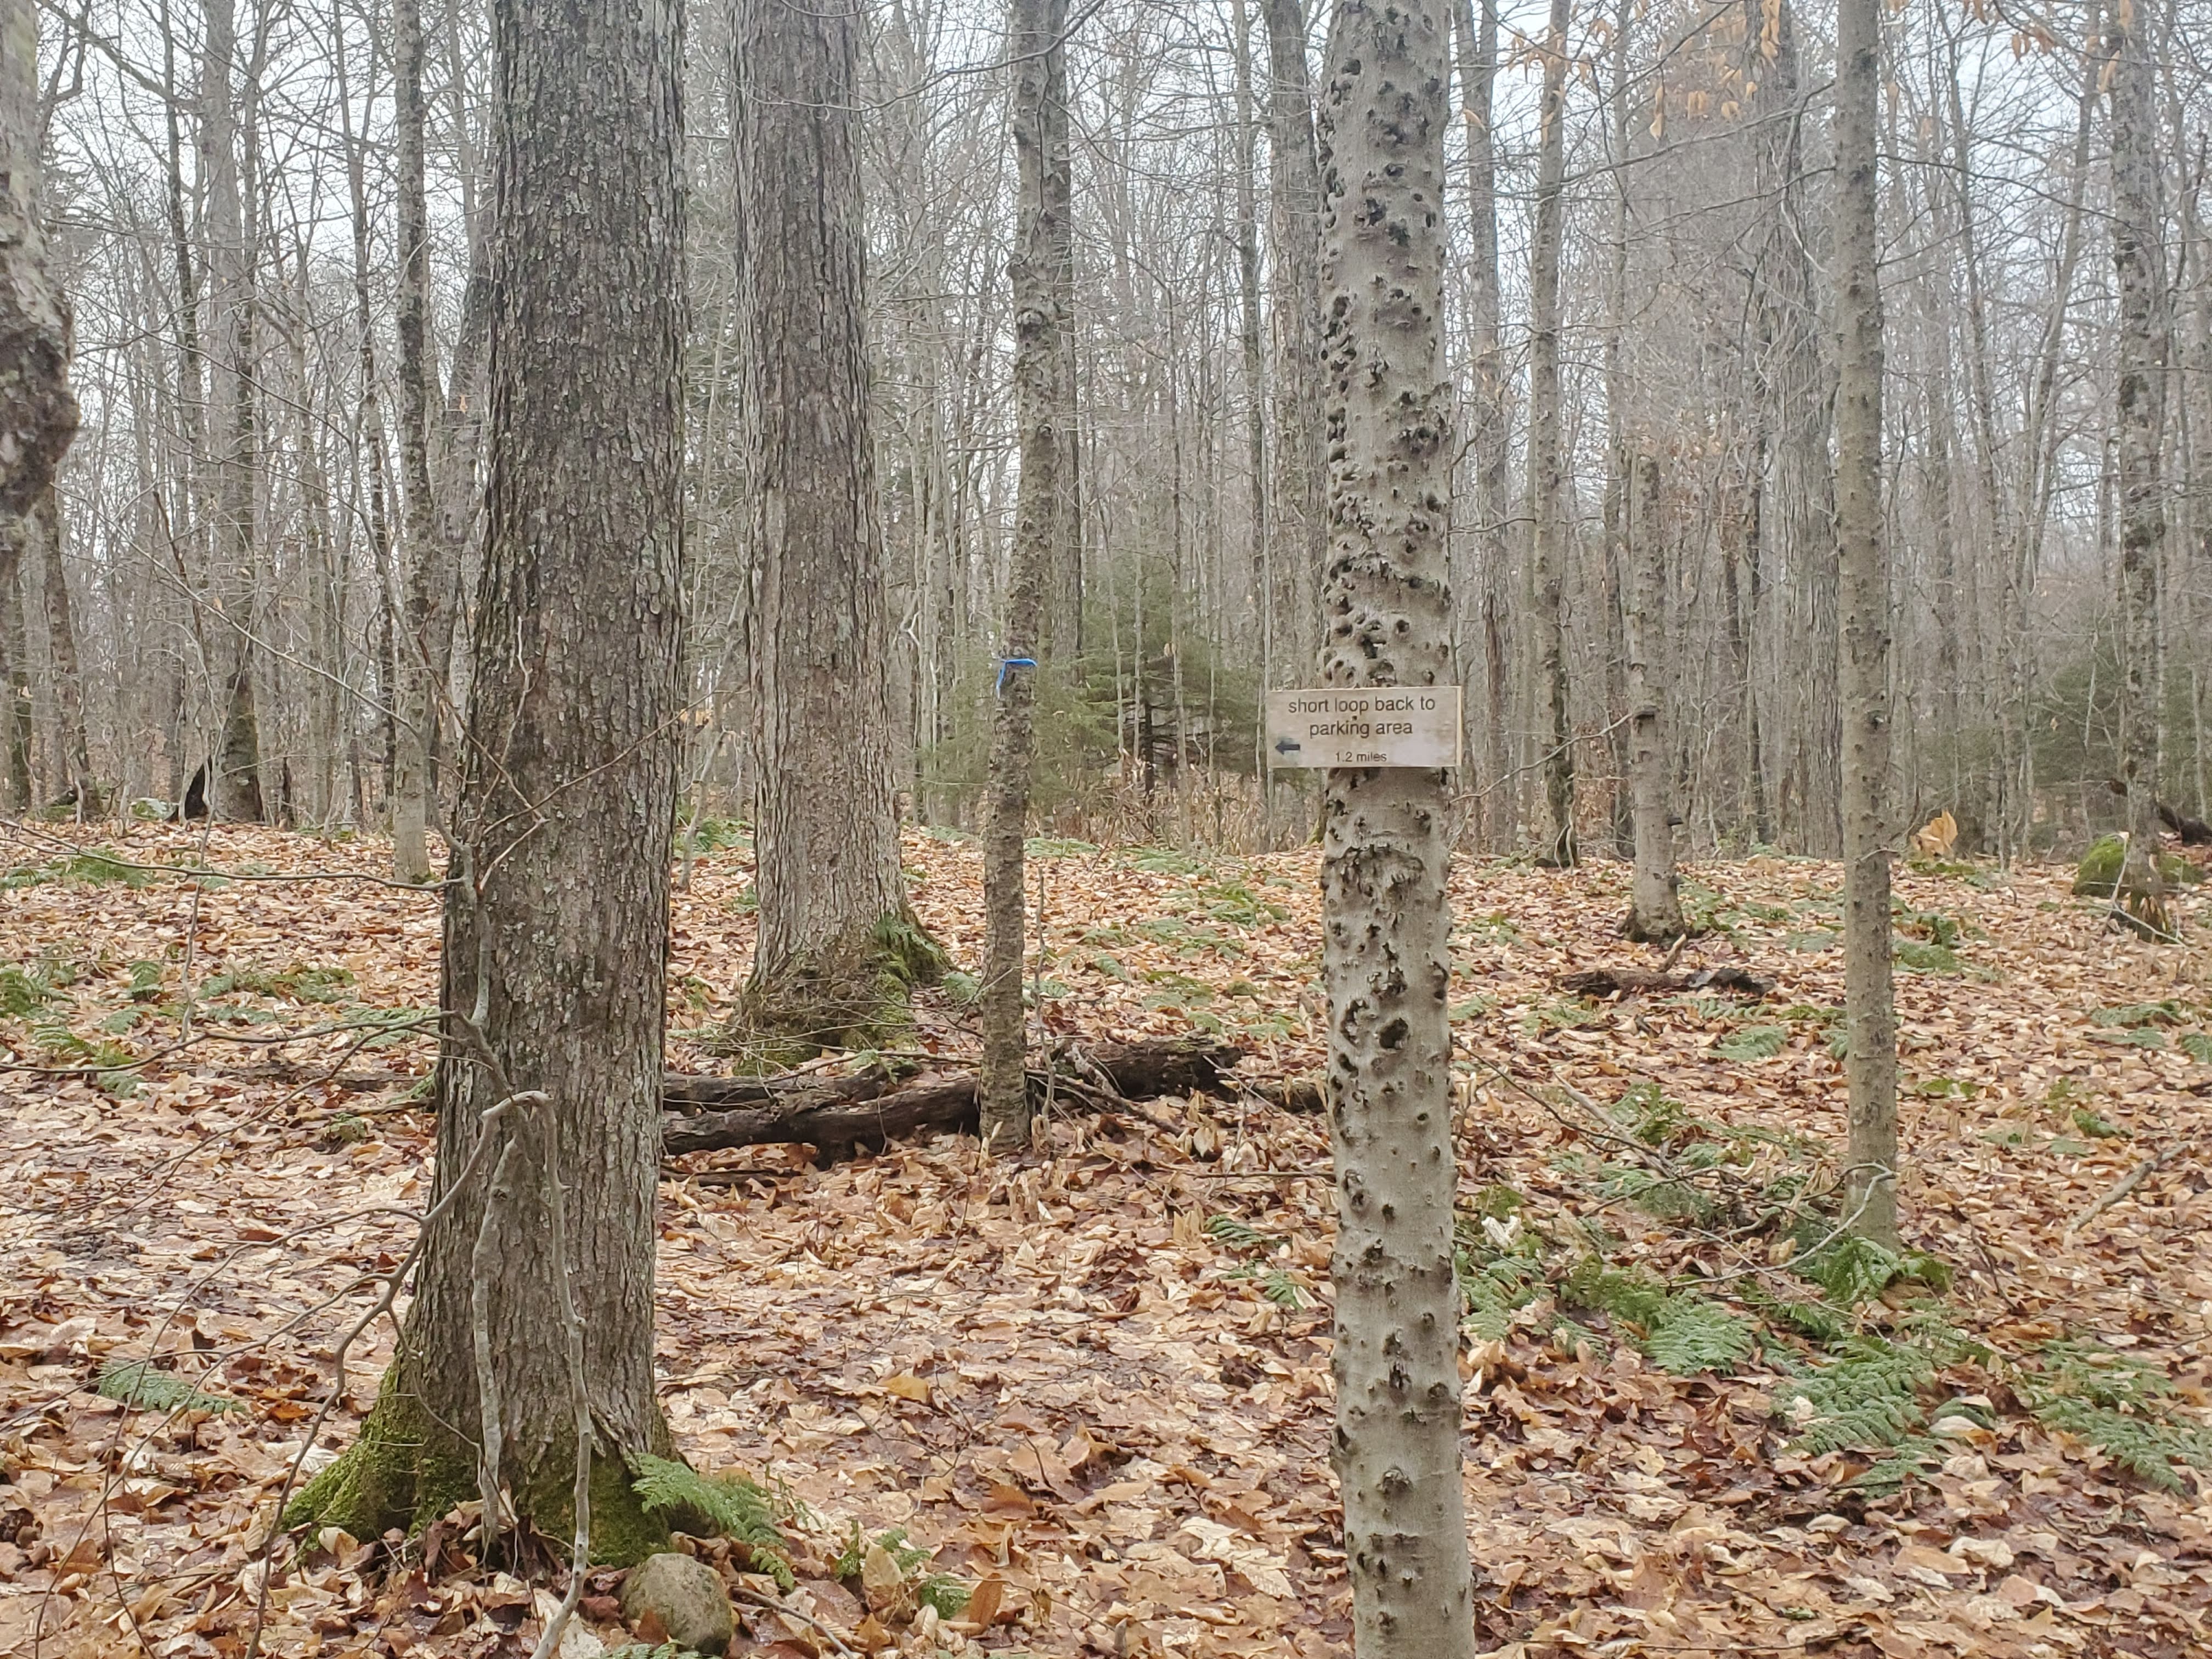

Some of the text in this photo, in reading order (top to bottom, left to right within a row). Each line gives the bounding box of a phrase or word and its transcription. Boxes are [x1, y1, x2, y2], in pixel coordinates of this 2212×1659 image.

[1288, 696, 1436, 715] short loop back to
[1310, 720, 1413, 738] parking area
[1335, 752, 1387, 763] 1.2 miles
